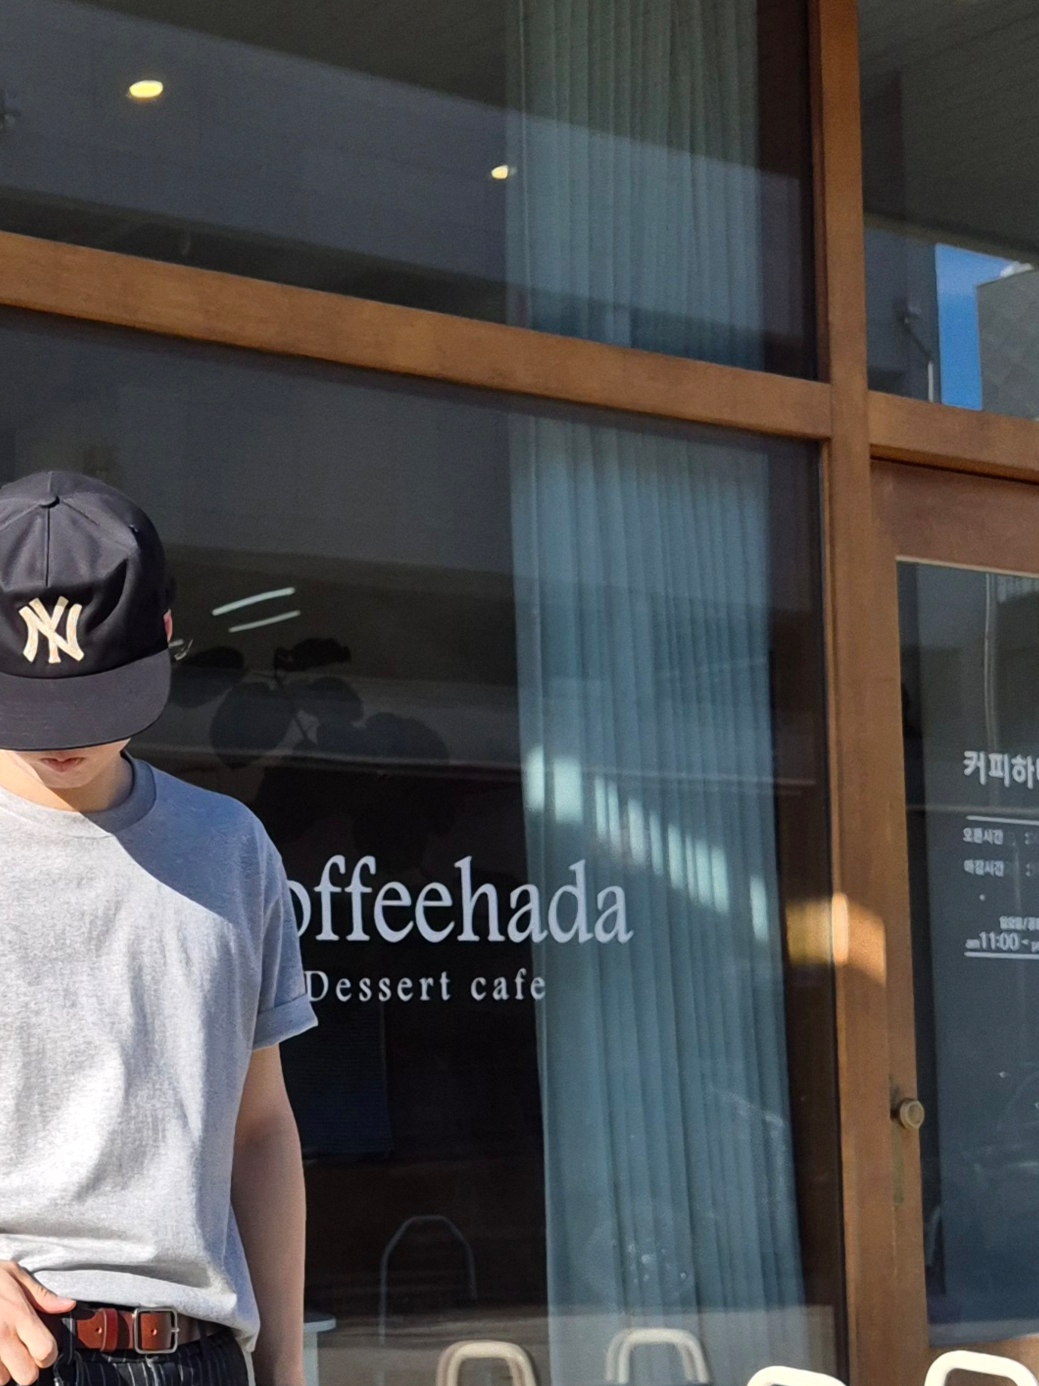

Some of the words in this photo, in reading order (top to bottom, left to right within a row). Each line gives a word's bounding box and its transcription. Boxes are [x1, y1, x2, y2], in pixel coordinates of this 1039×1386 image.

[963, 750, 1039, 789] 커피하
[304, 970, 451, 1002] Dessert
[470, 968, 547, 1001] cafe
